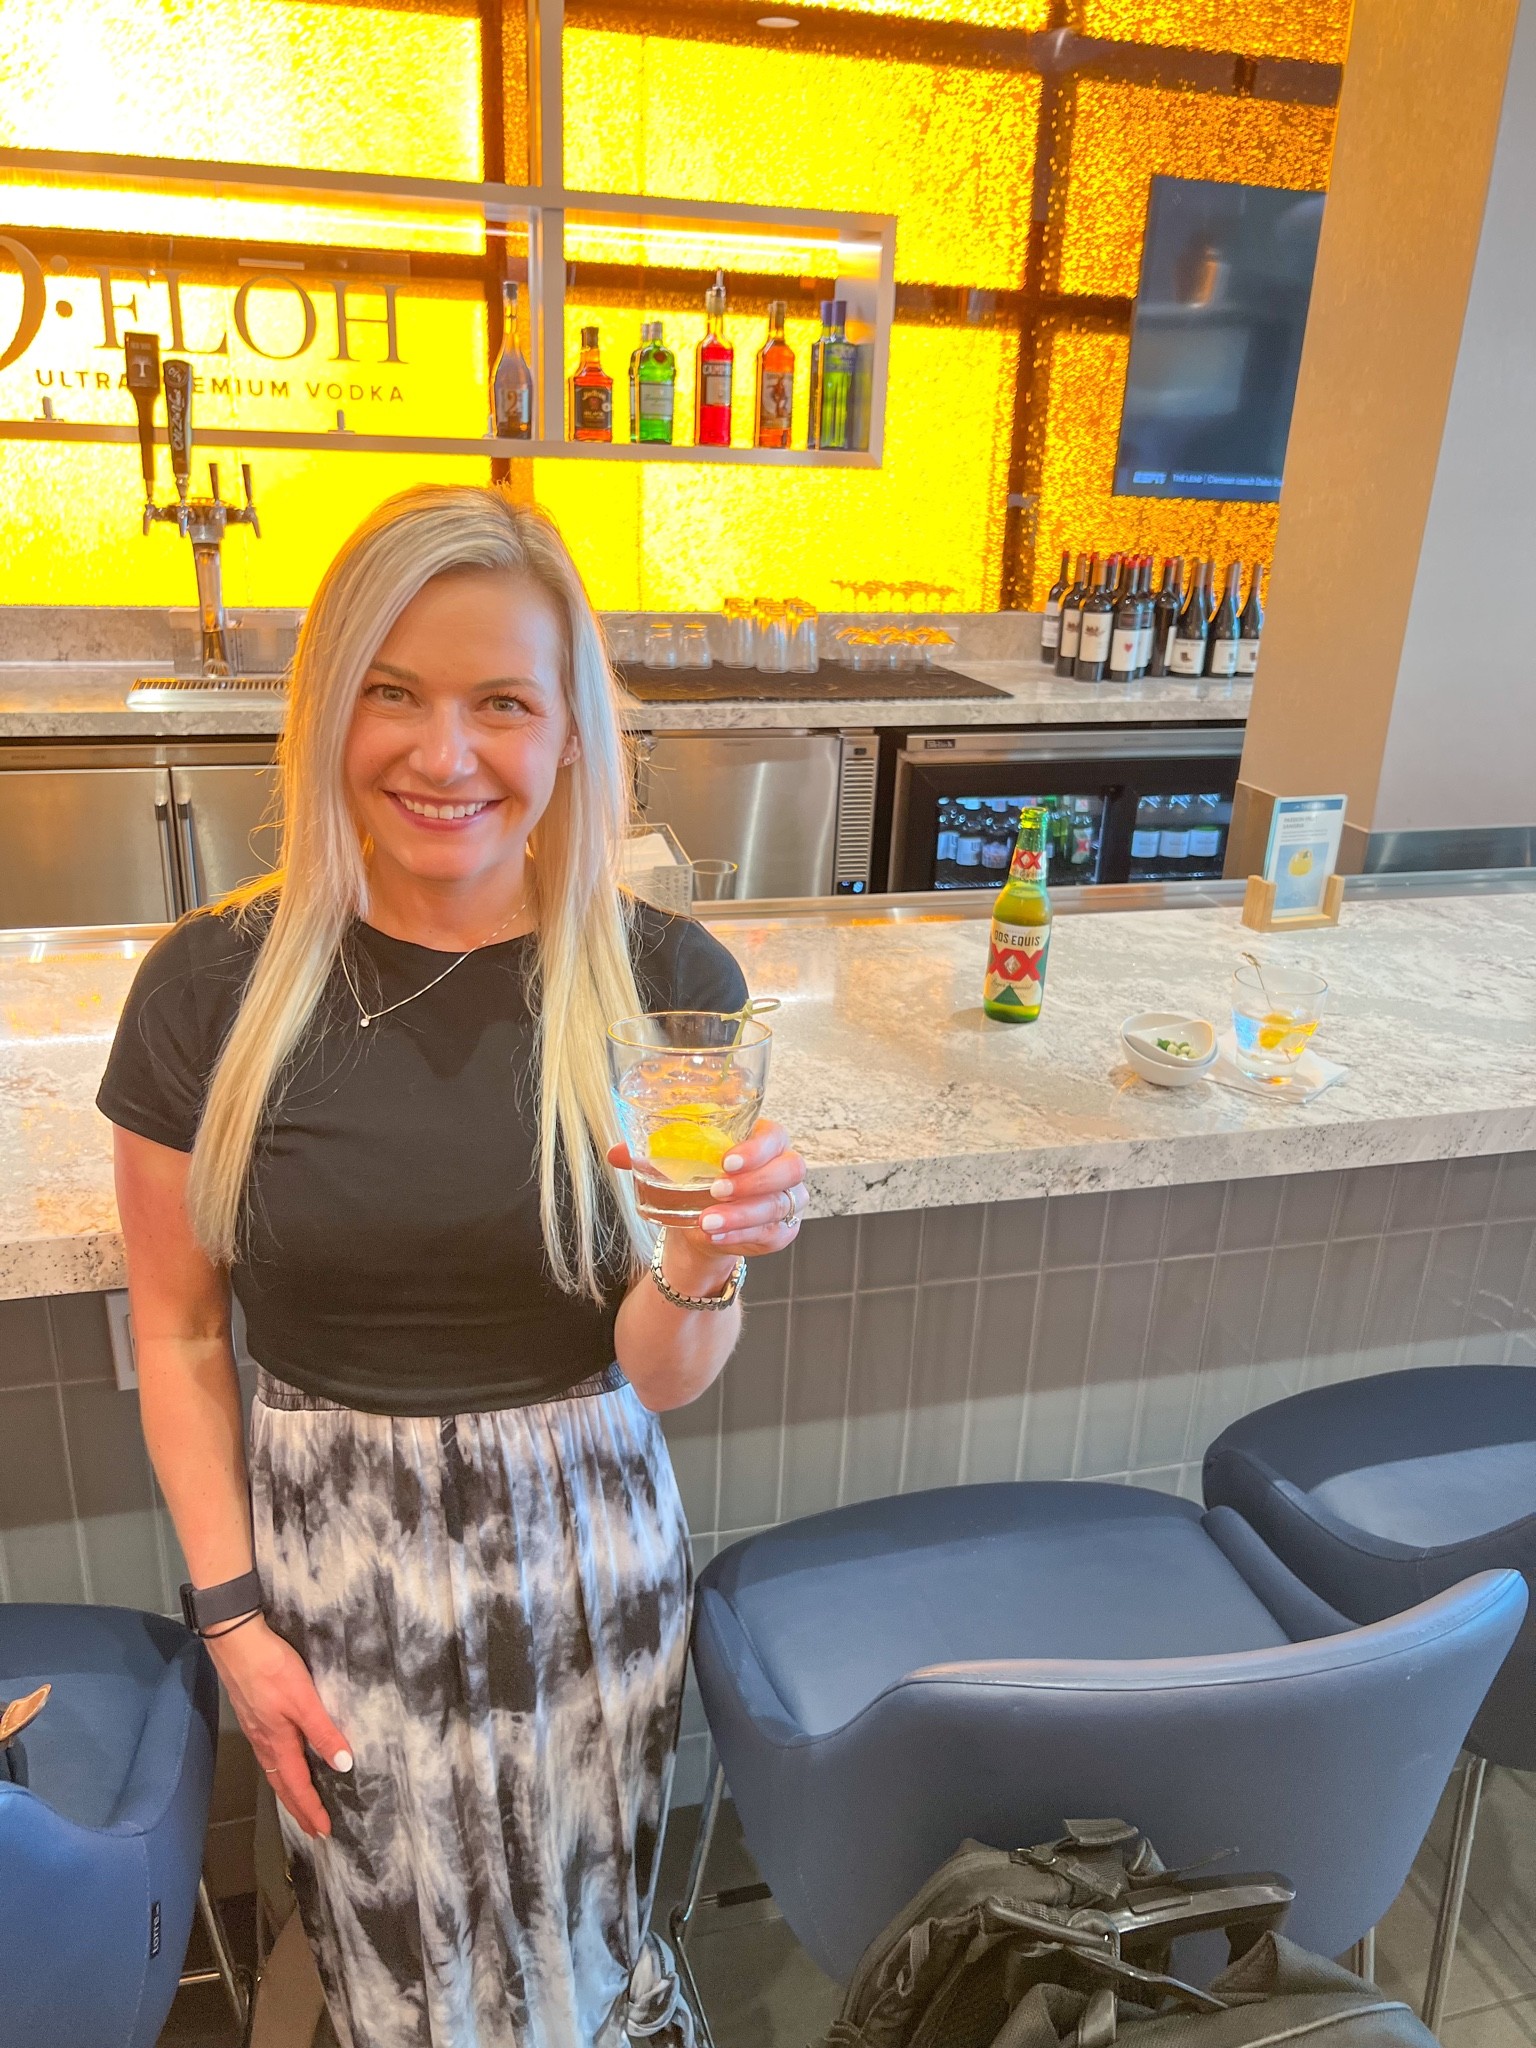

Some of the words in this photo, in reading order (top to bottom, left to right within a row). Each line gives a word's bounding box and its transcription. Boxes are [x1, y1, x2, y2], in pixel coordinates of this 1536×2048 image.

[191, 376, 290, 398] EMIUM
[305, 381, 405, 403] VODKA
[1011, 935, 1041, 947] EQUIS
[988, 942, 1044, 982] XX
